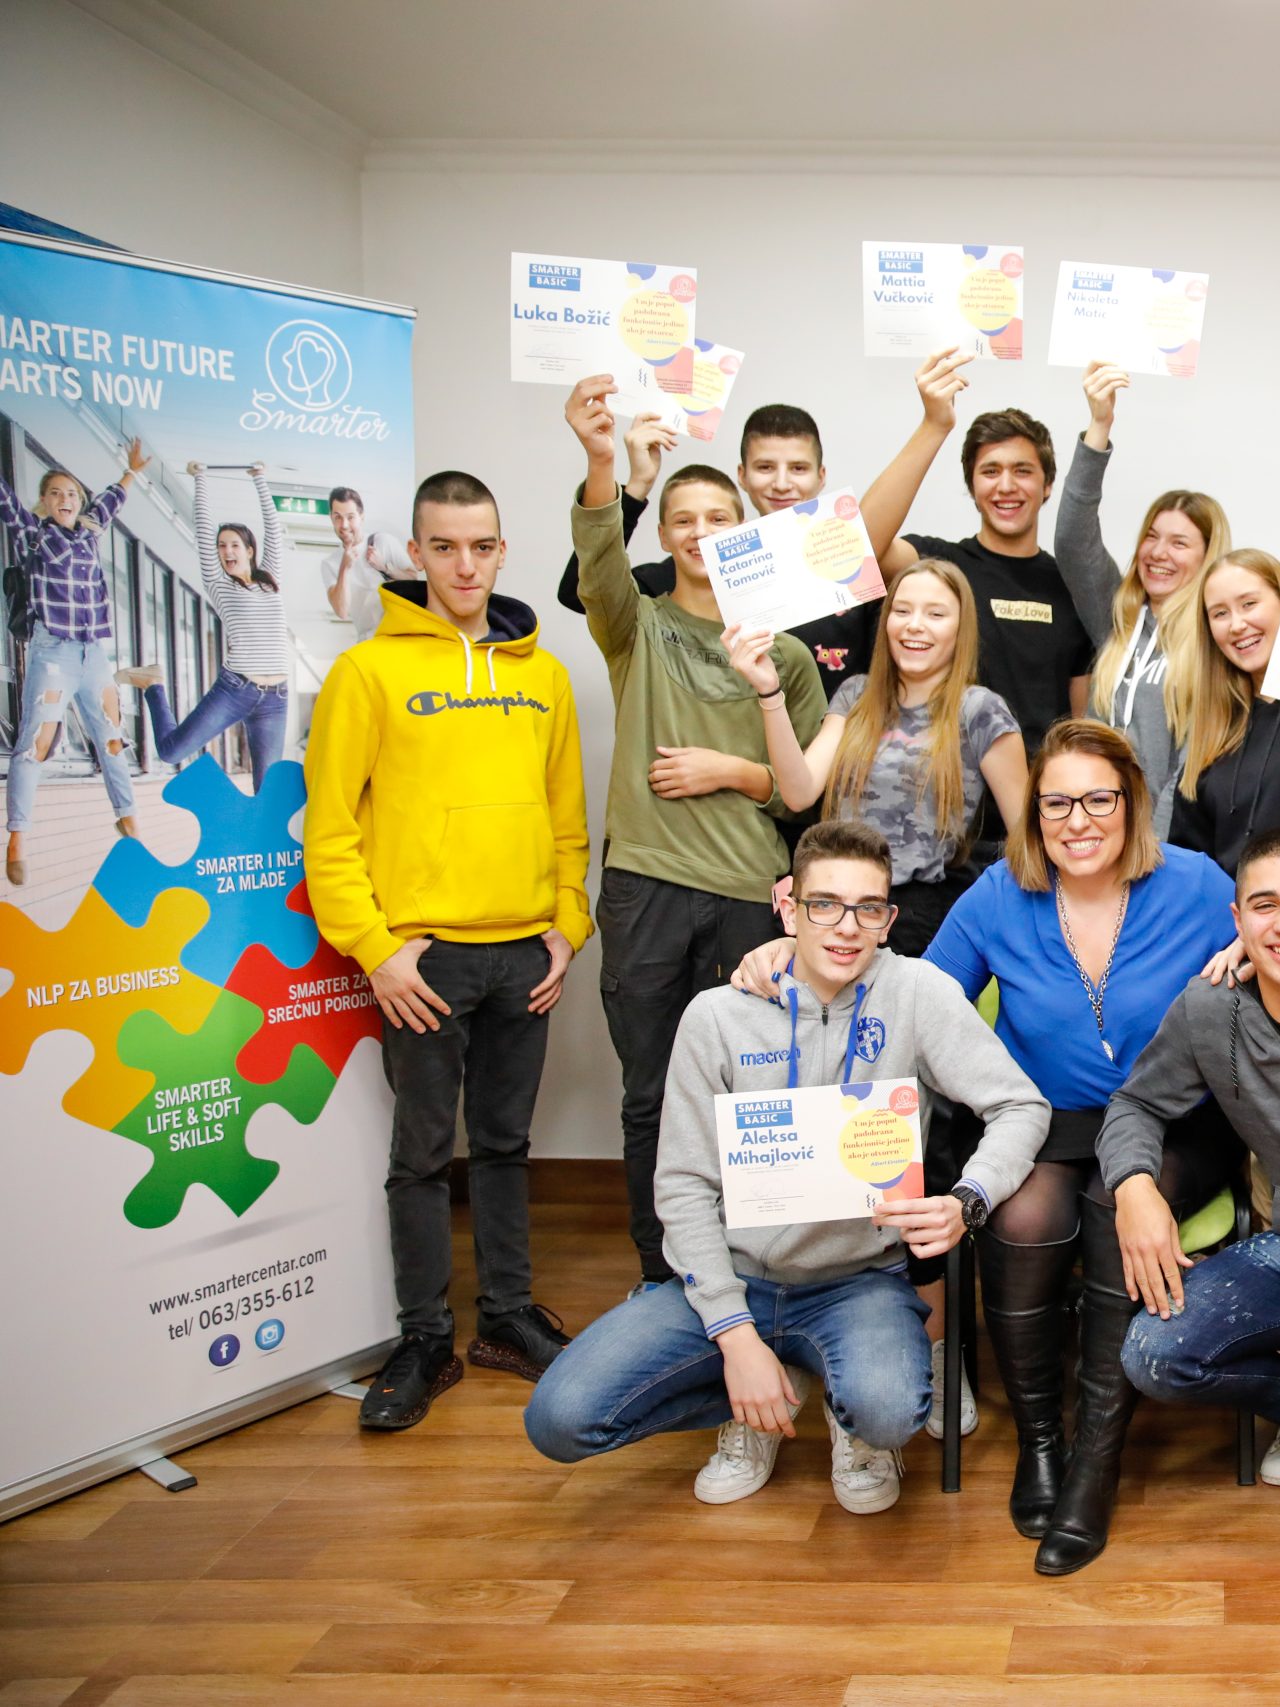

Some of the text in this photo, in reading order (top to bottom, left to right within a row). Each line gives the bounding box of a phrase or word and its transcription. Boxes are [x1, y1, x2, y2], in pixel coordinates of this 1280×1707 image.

[531, 264, 578, 276] SMARTER
[536, 277, 567, 287] BASIC
[881, 274, 925, 287] Mattia
[873, 290, 934, 304] Vučković
[514, 303, 610, 326] Luka Božić
[123, 334, 236, 382] FUTURE
[0, 358, 164, 411] ARTS NOW
[240, 388, 391, 442] Smarter
[717, 530, 758, 550] SMARTER
[724, 543, 751, 558] BASIC
[718, 552, 773, 576] Katarina
[724, 563, 776, 589] Tomović
[196, 850, 302, 876] SMARTER I NLP
[216, 870, 286, 894] ZA MLADE
[27, 966, 181, 1008] NLP ZA BUSINESS
[288, 974, 369, 1000] SMARTER ZA
[268, 1000, 321, 1024] SREĆNU
[154, 1077, 232, 1110] SMARTER
[146, 1096, 242, 1134] LIFE & SOFT
[738, 1101, 790, 1114] SMARTER
[744, 1114, 778, 1124] BASIC
[169, 1123, 225, 1152] SKILLS
[740, 1129, 798, 1146] Aleksa
[728, 1146, 814, 1168] Mihajlović
[149, 1248, 328, 1316] www.smartercentar.com
[168, 1275, 315, 1340] tel/ 063/355-612
